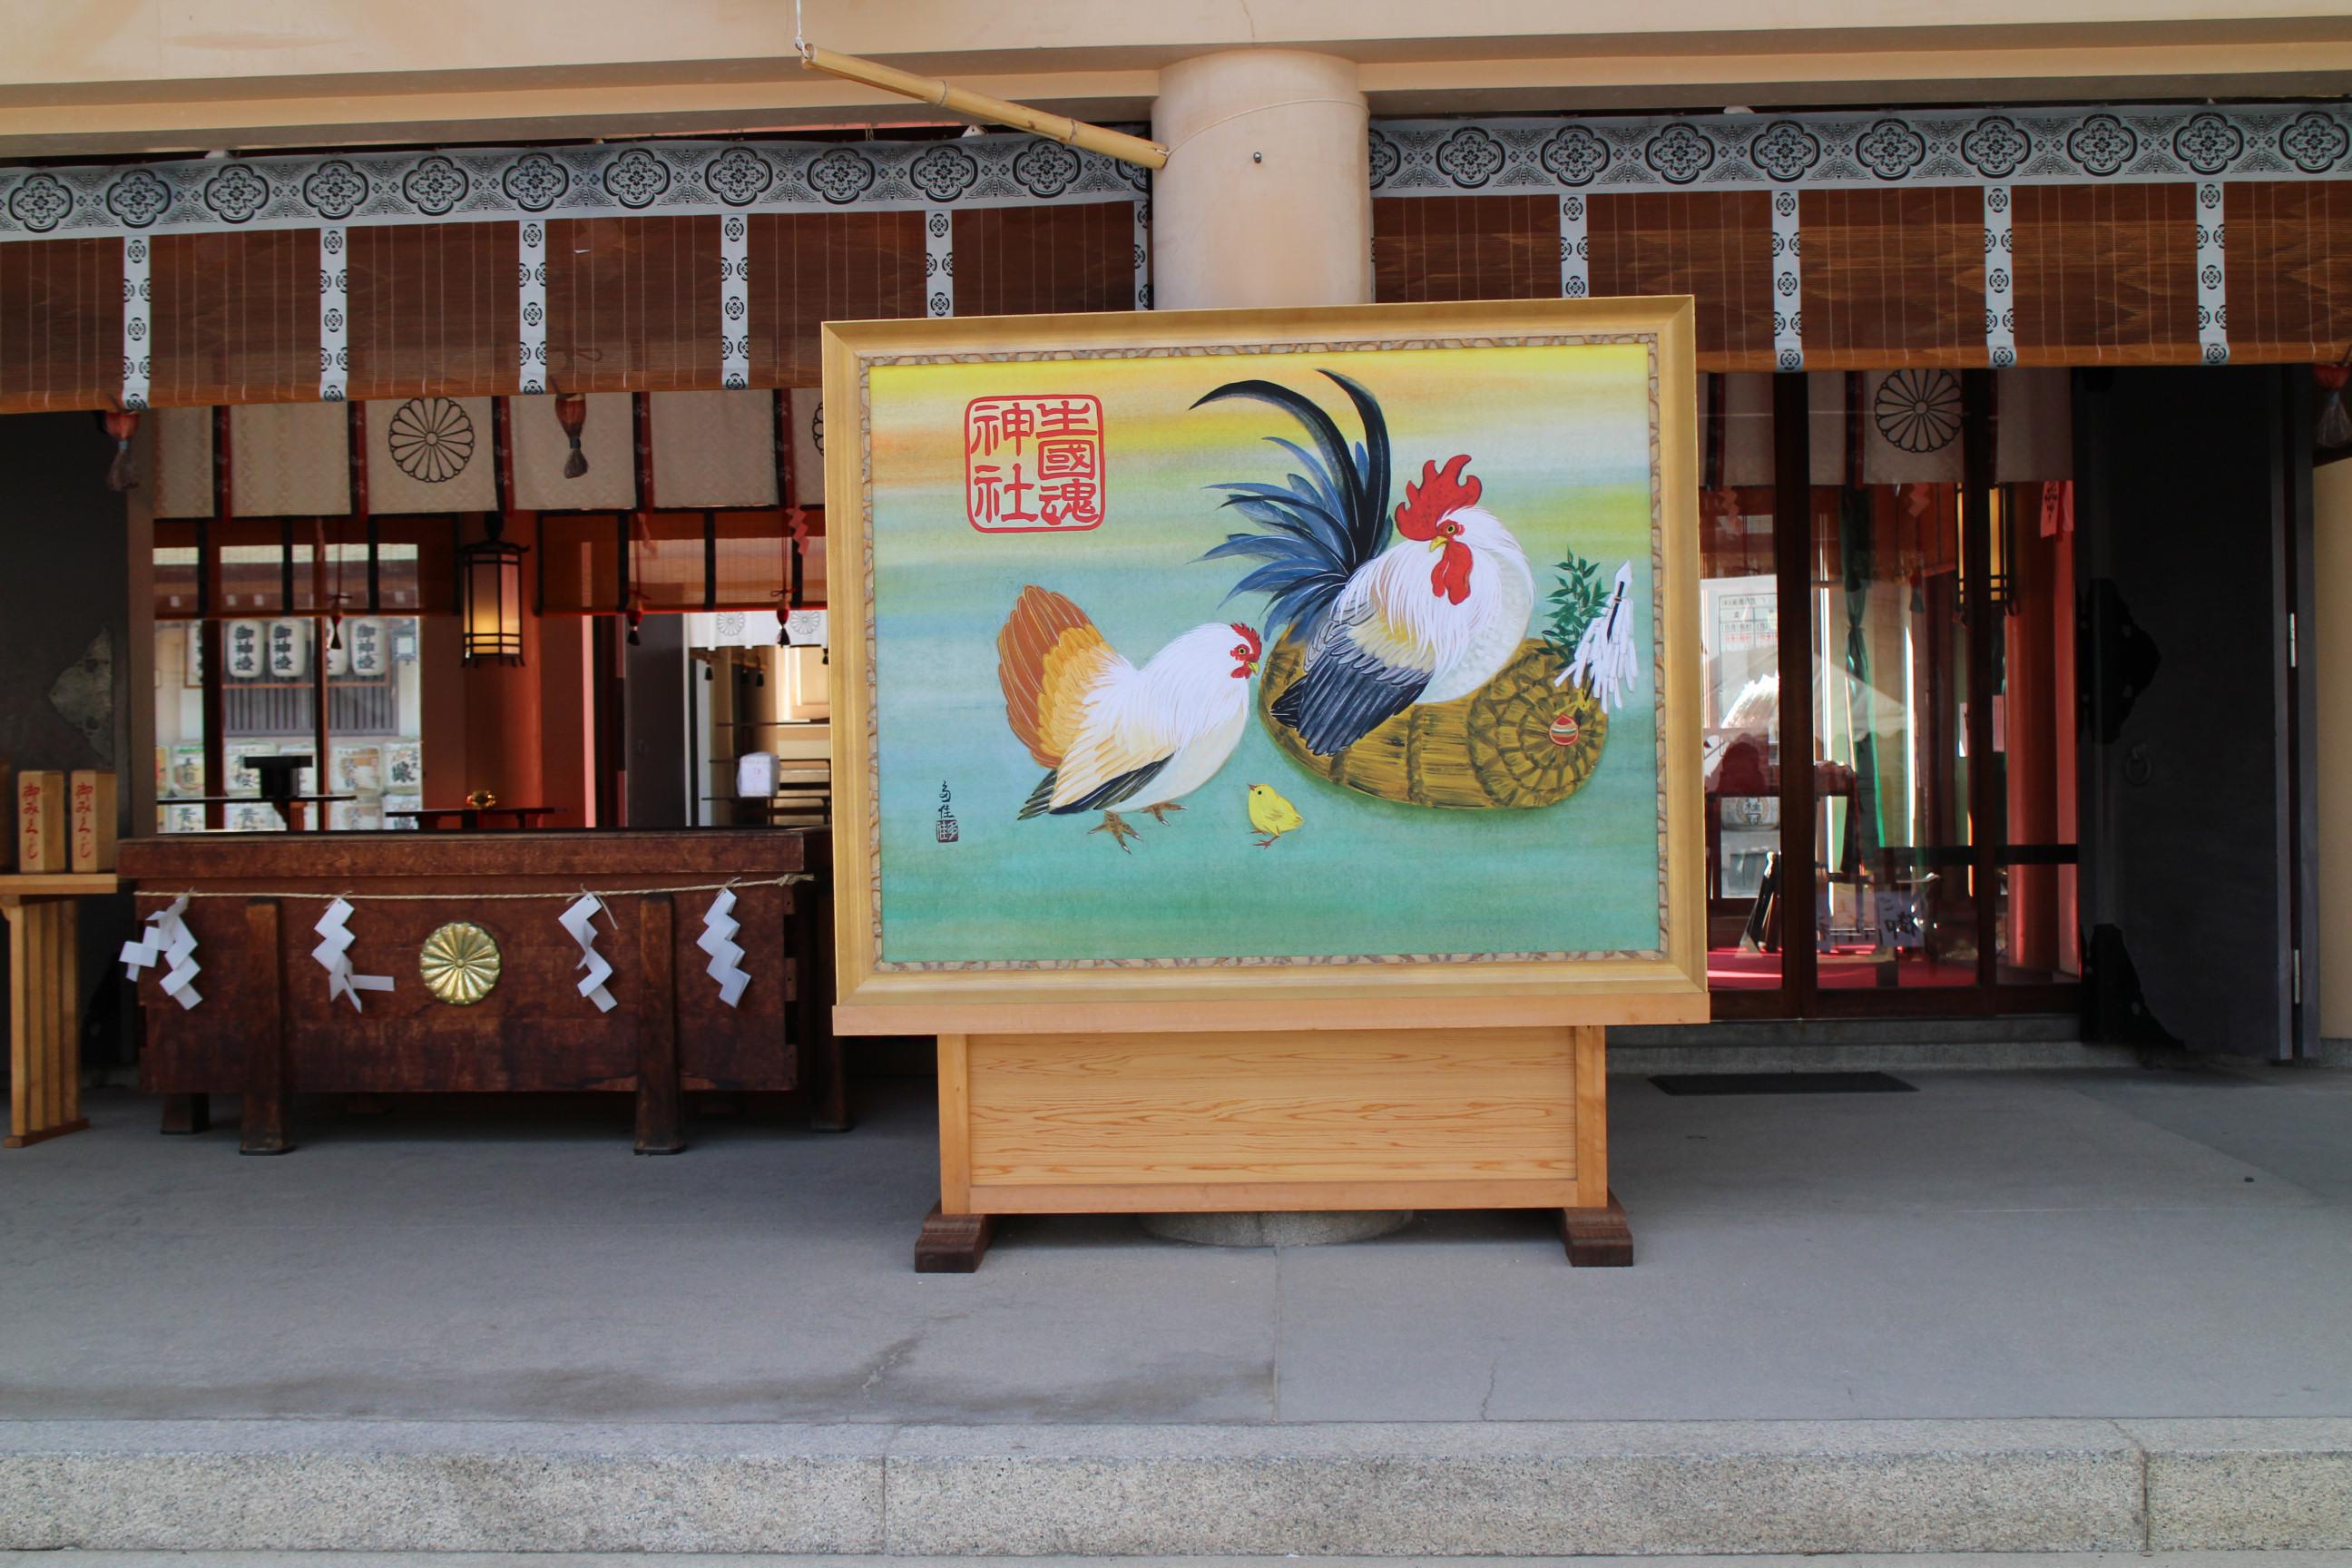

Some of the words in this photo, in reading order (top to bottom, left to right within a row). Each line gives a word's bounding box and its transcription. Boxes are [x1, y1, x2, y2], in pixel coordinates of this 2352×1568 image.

[971, 402, 1038, 523] 神社
[1036, 401, 1099, 525] 生國魂
